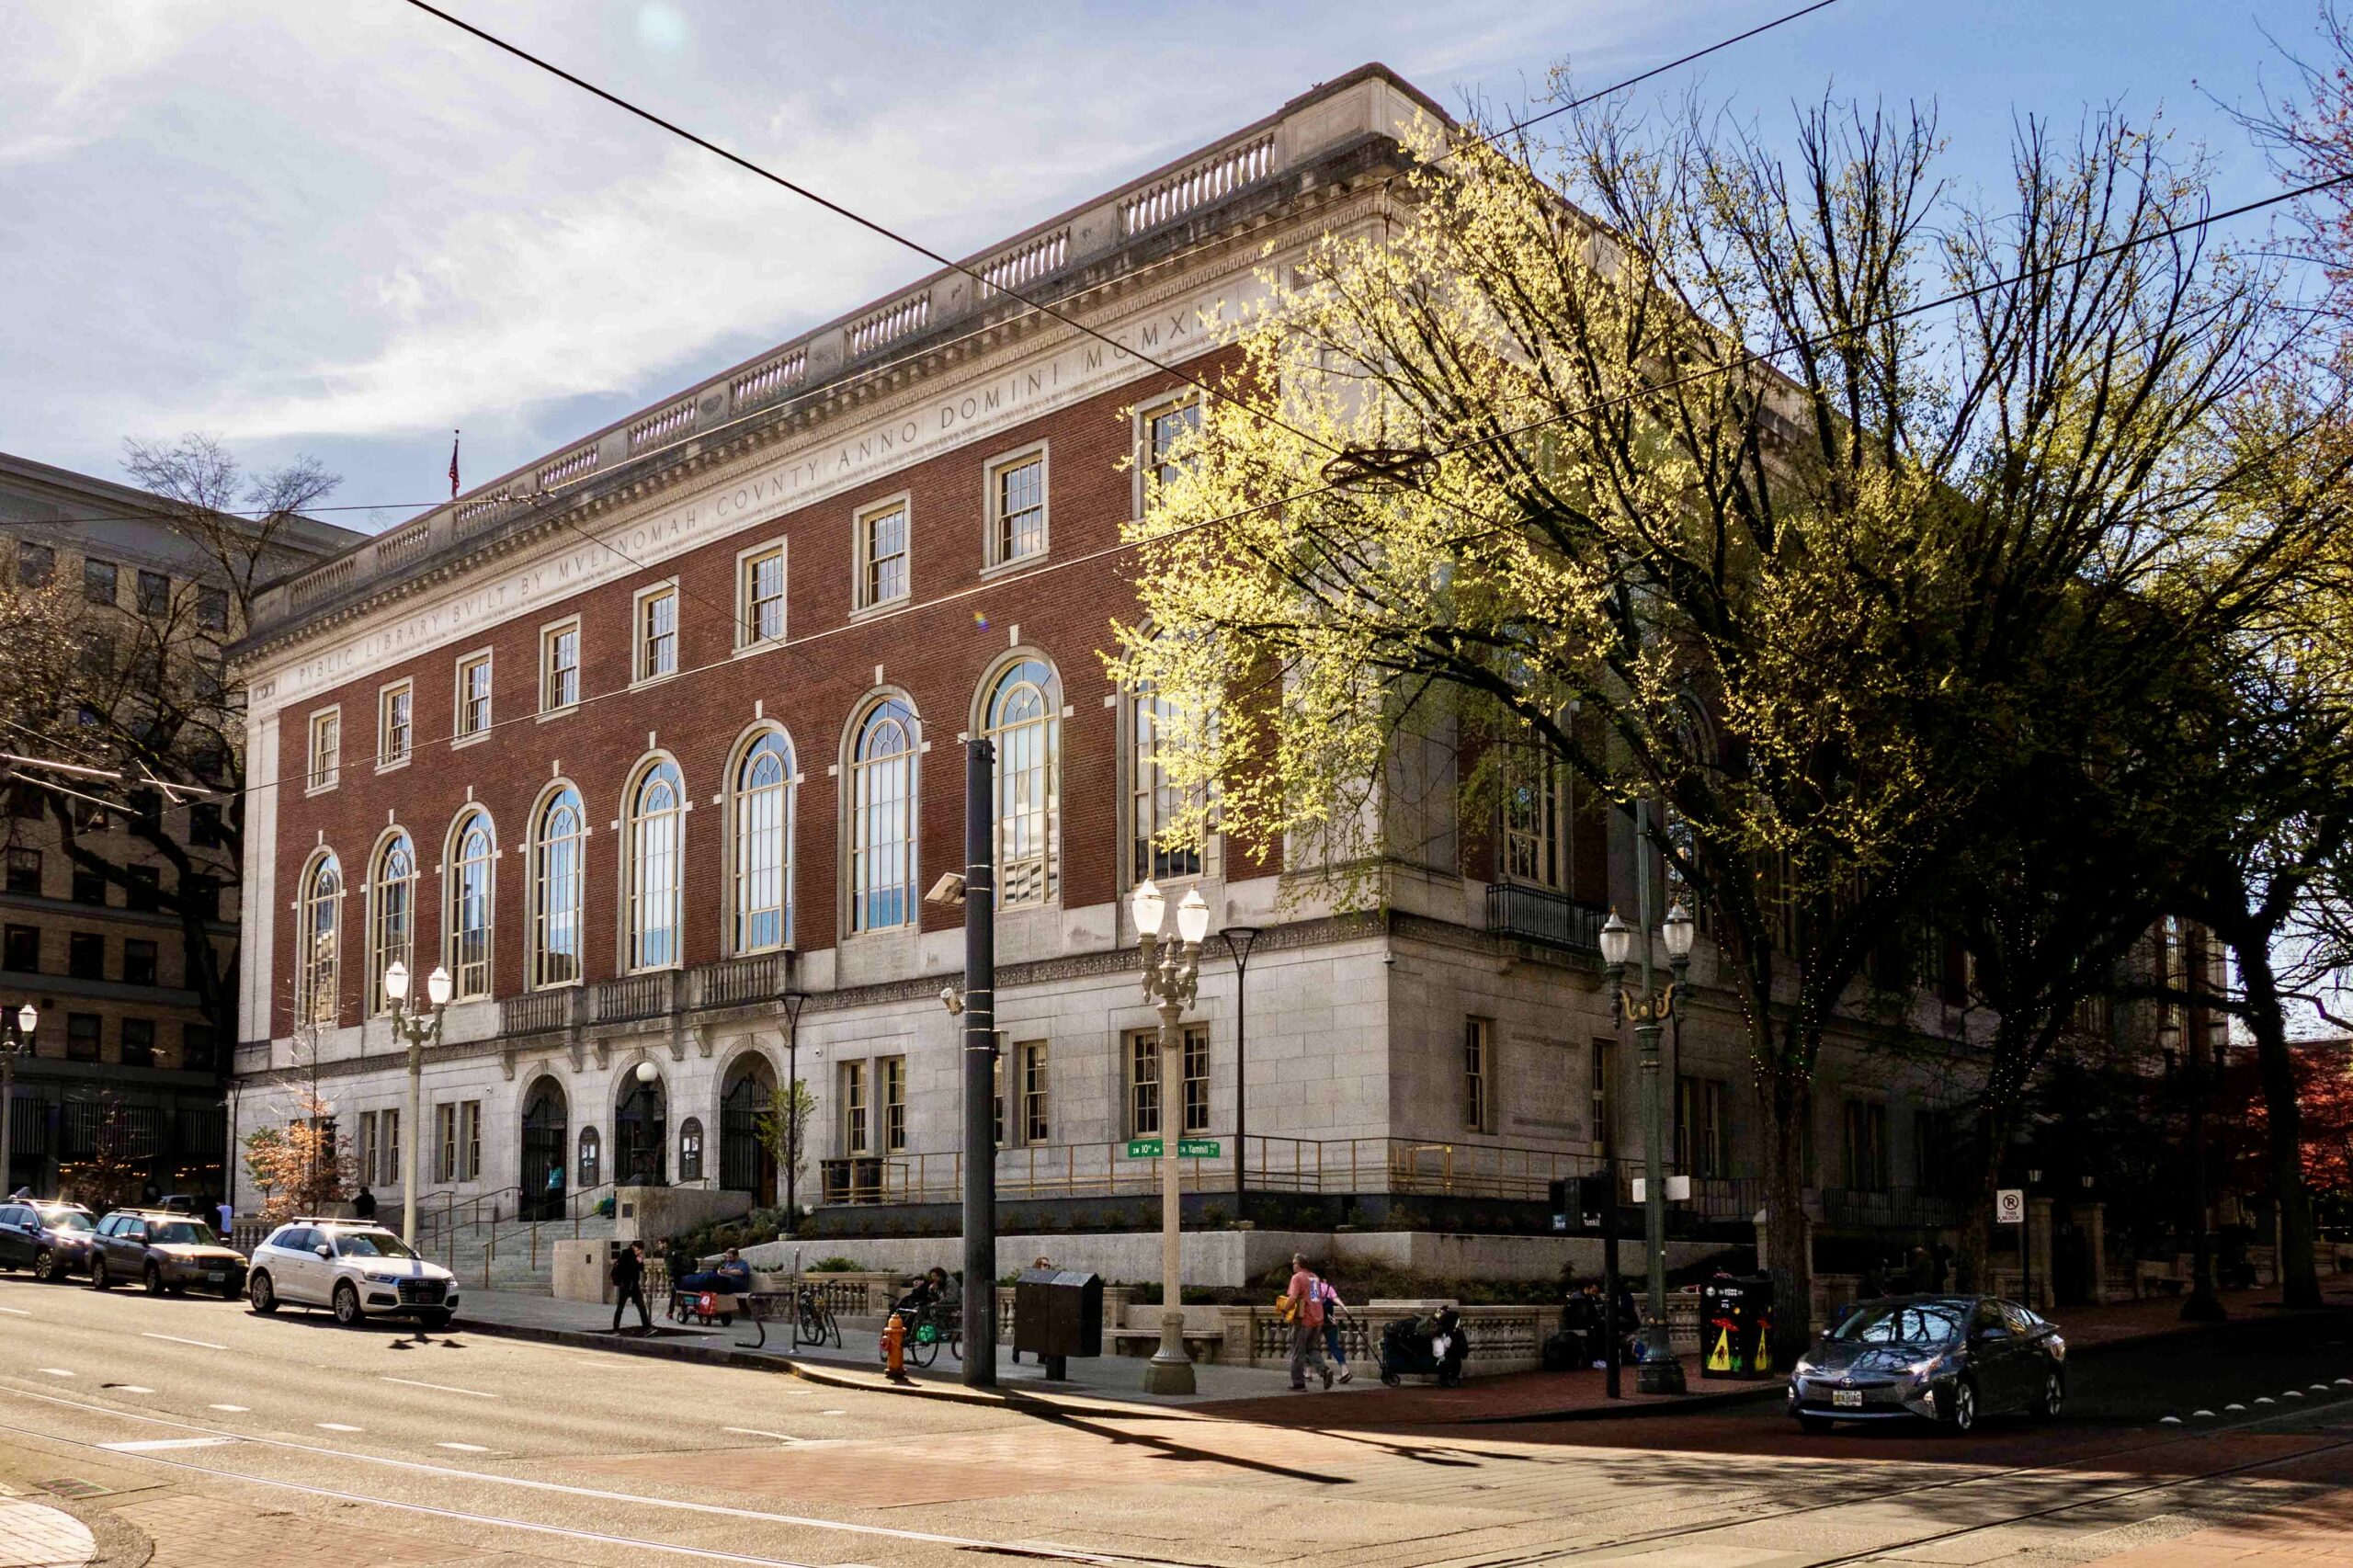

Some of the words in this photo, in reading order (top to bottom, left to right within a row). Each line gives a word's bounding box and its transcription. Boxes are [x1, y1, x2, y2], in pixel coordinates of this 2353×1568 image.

[299, 649, 354, 684] PVBLIC
[366, 612, 440, 657] LIBRARY
[453, 586, 506, 623] BVILT
[521, 571, 543, 596] BY
[558, 508, 697, 582] MVLTNOMAH
[717, 459, 818, 517] COVNTY
[837, 422, 916, 471] ANNO
[940, 362, 1057, 429] DOMINI
[1188, 1144, 1209, 1153] Yamhill
